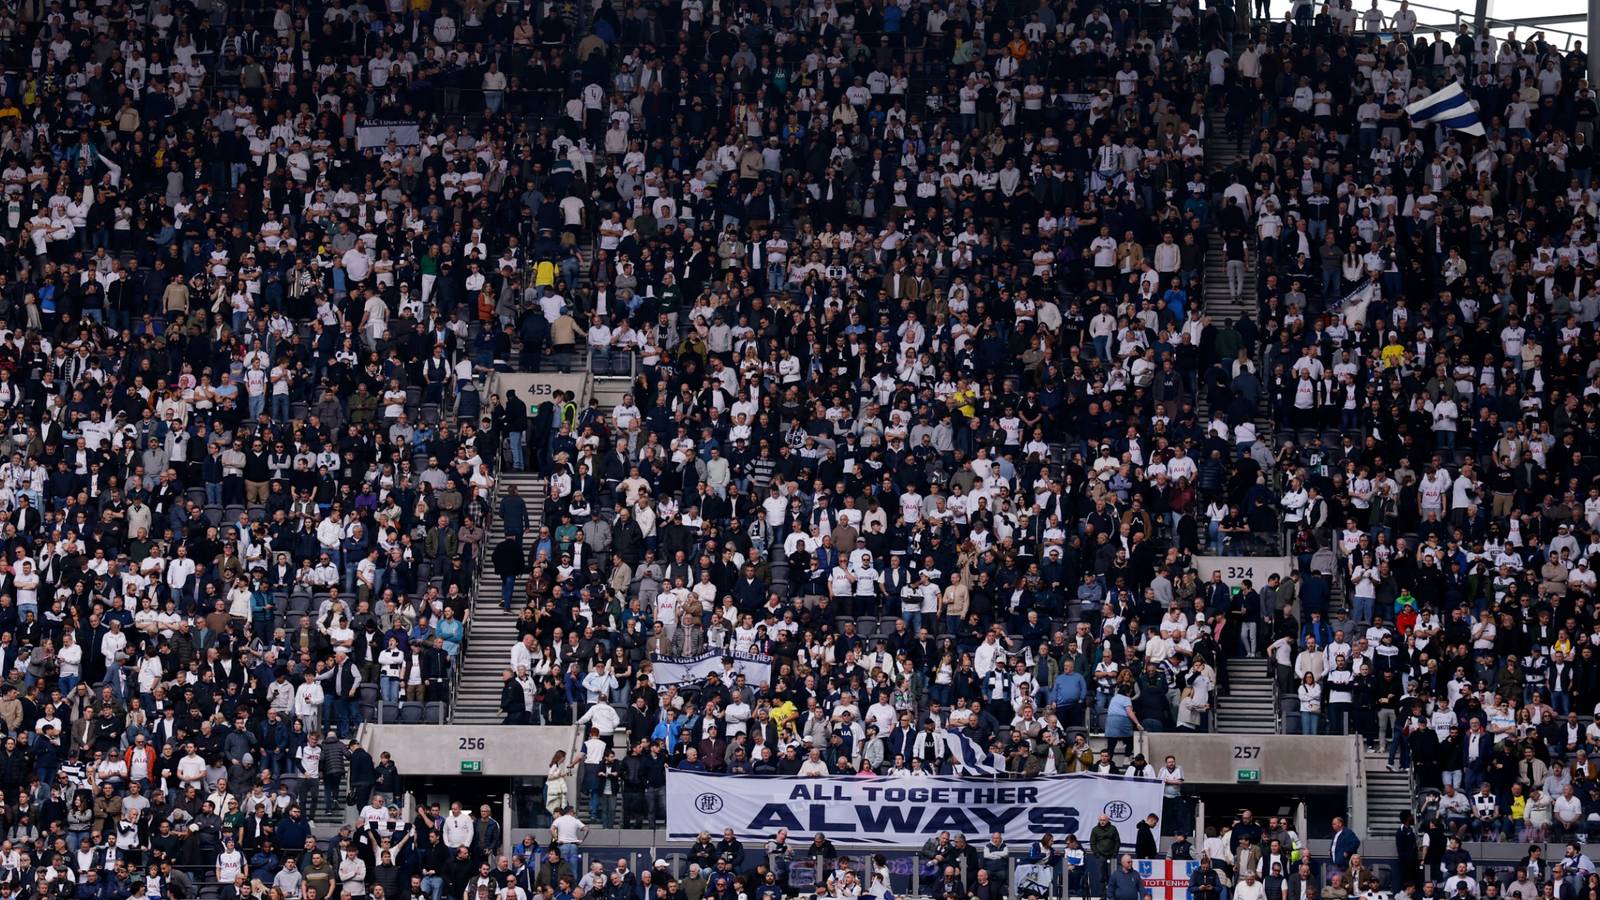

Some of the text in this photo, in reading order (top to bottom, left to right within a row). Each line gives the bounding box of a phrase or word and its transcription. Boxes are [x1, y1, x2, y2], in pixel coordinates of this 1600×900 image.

[528, 384, 552, 395] 453
[1228, 566, 1254, 578] 324
[459, 738, 484, 750] 256
[1234, 746, 1260, 758] 257
[789, 784, 1038, 804] ALL TOGETHER
[746, 803, 1080, 834] ALWAYS
